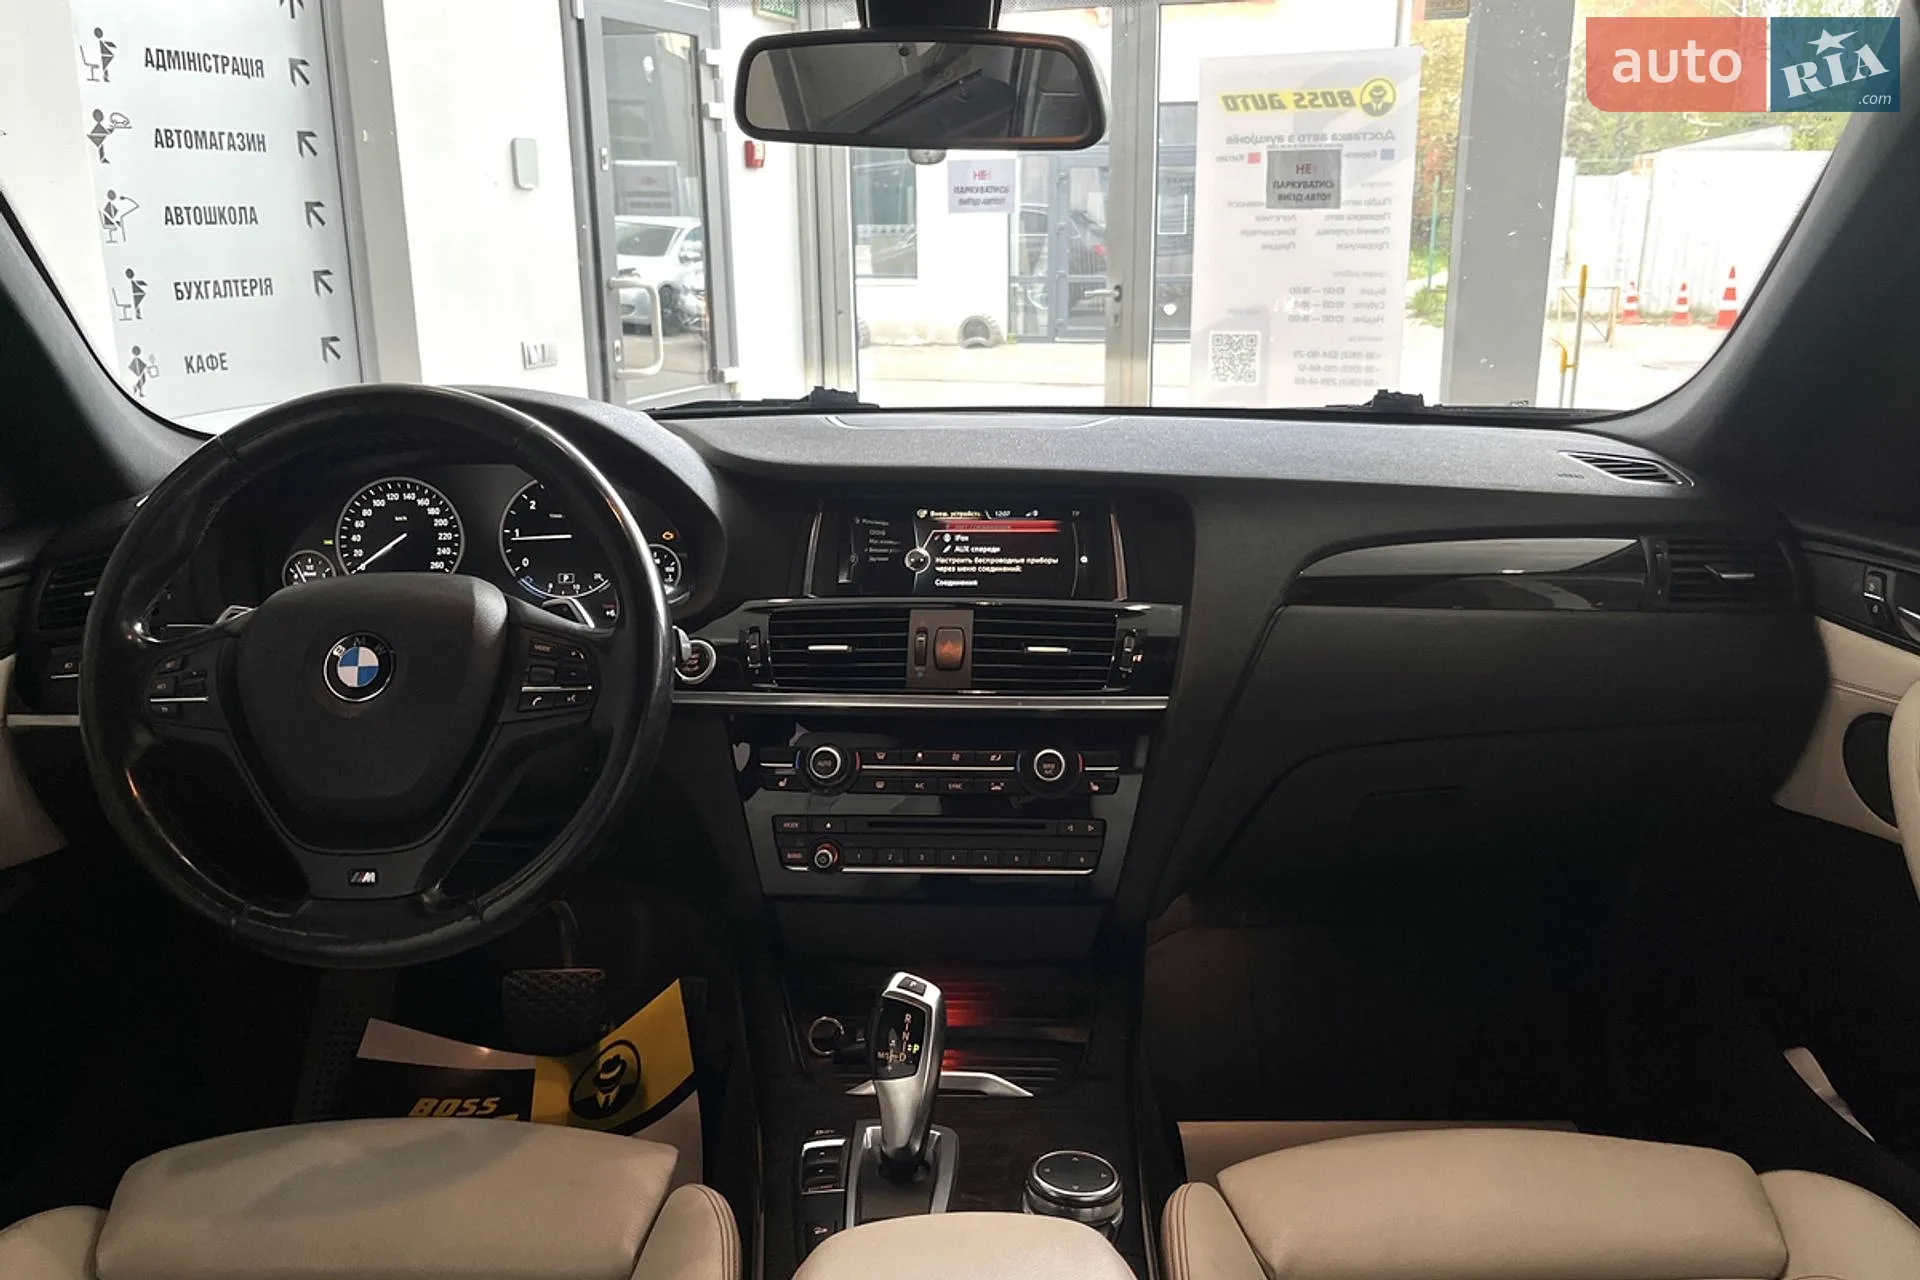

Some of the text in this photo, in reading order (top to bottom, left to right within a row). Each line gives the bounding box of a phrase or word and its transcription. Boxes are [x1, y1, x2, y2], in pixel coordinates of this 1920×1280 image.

[144, 46, 265, 80] АДМІНІСТРАЦІЯ
[154, 127, 267, 153] АВТОМАГАЗИН
[164, 205, 259, 227] АВТОШКОЛА
[174, 276, 274, 301] БУХГАЛТЕРІЯ
[184, 352, 229, 376] КАФЕ
[386, 493, 400, 501] 120
[402, 493, 416, 501] 140
[372, 499, 386, 507] 100
[416, 498, 430, 507] 160
[530, 501, 536, 510] 2
[361, 509, 372, 517] 80
[354, 520, 365, 528] 60
[350, 534, 361, 542] 40
[353, 549, 364, 557] 20
[436, 547, 451, 555] 240
[429, 561, 444, 569] 260
[521, 557, 529, 567] 0
[1026, 557, 1059, 565] приборы
[904, 1013, 912, 1023] R
[902, 1031, 910, 1041] N
[899, 1052, 907, 1062] D
[408, 1096, 500, 1117] BOSS
